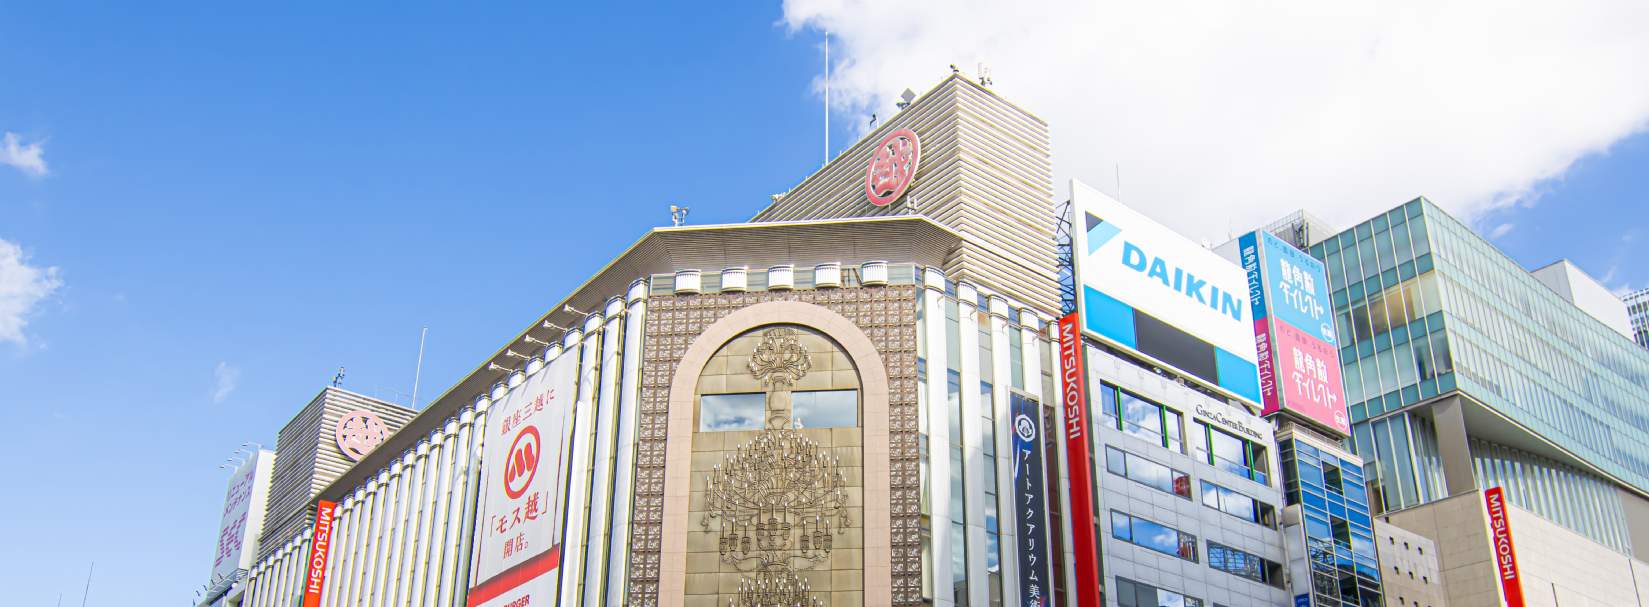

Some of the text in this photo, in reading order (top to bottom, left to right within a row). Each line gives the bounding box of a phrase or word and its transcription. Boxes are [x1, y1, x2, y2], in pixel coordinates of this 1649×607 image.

[1121, 240, 1243, 322] DAIKIN
[501, 389, 555, 435] 銀座三越に
[1062, 323, 1080, 440] MITSUKOSHI
[489, 490, 549, 538] 「モス越」
[503, 532, 529, 559] 開店。
[1488, 493, 1514, 580] MITSUKOSHI
[308, 506, 332, 593] MITSUKOSHI
[503, 594, 530, 607] RGER
